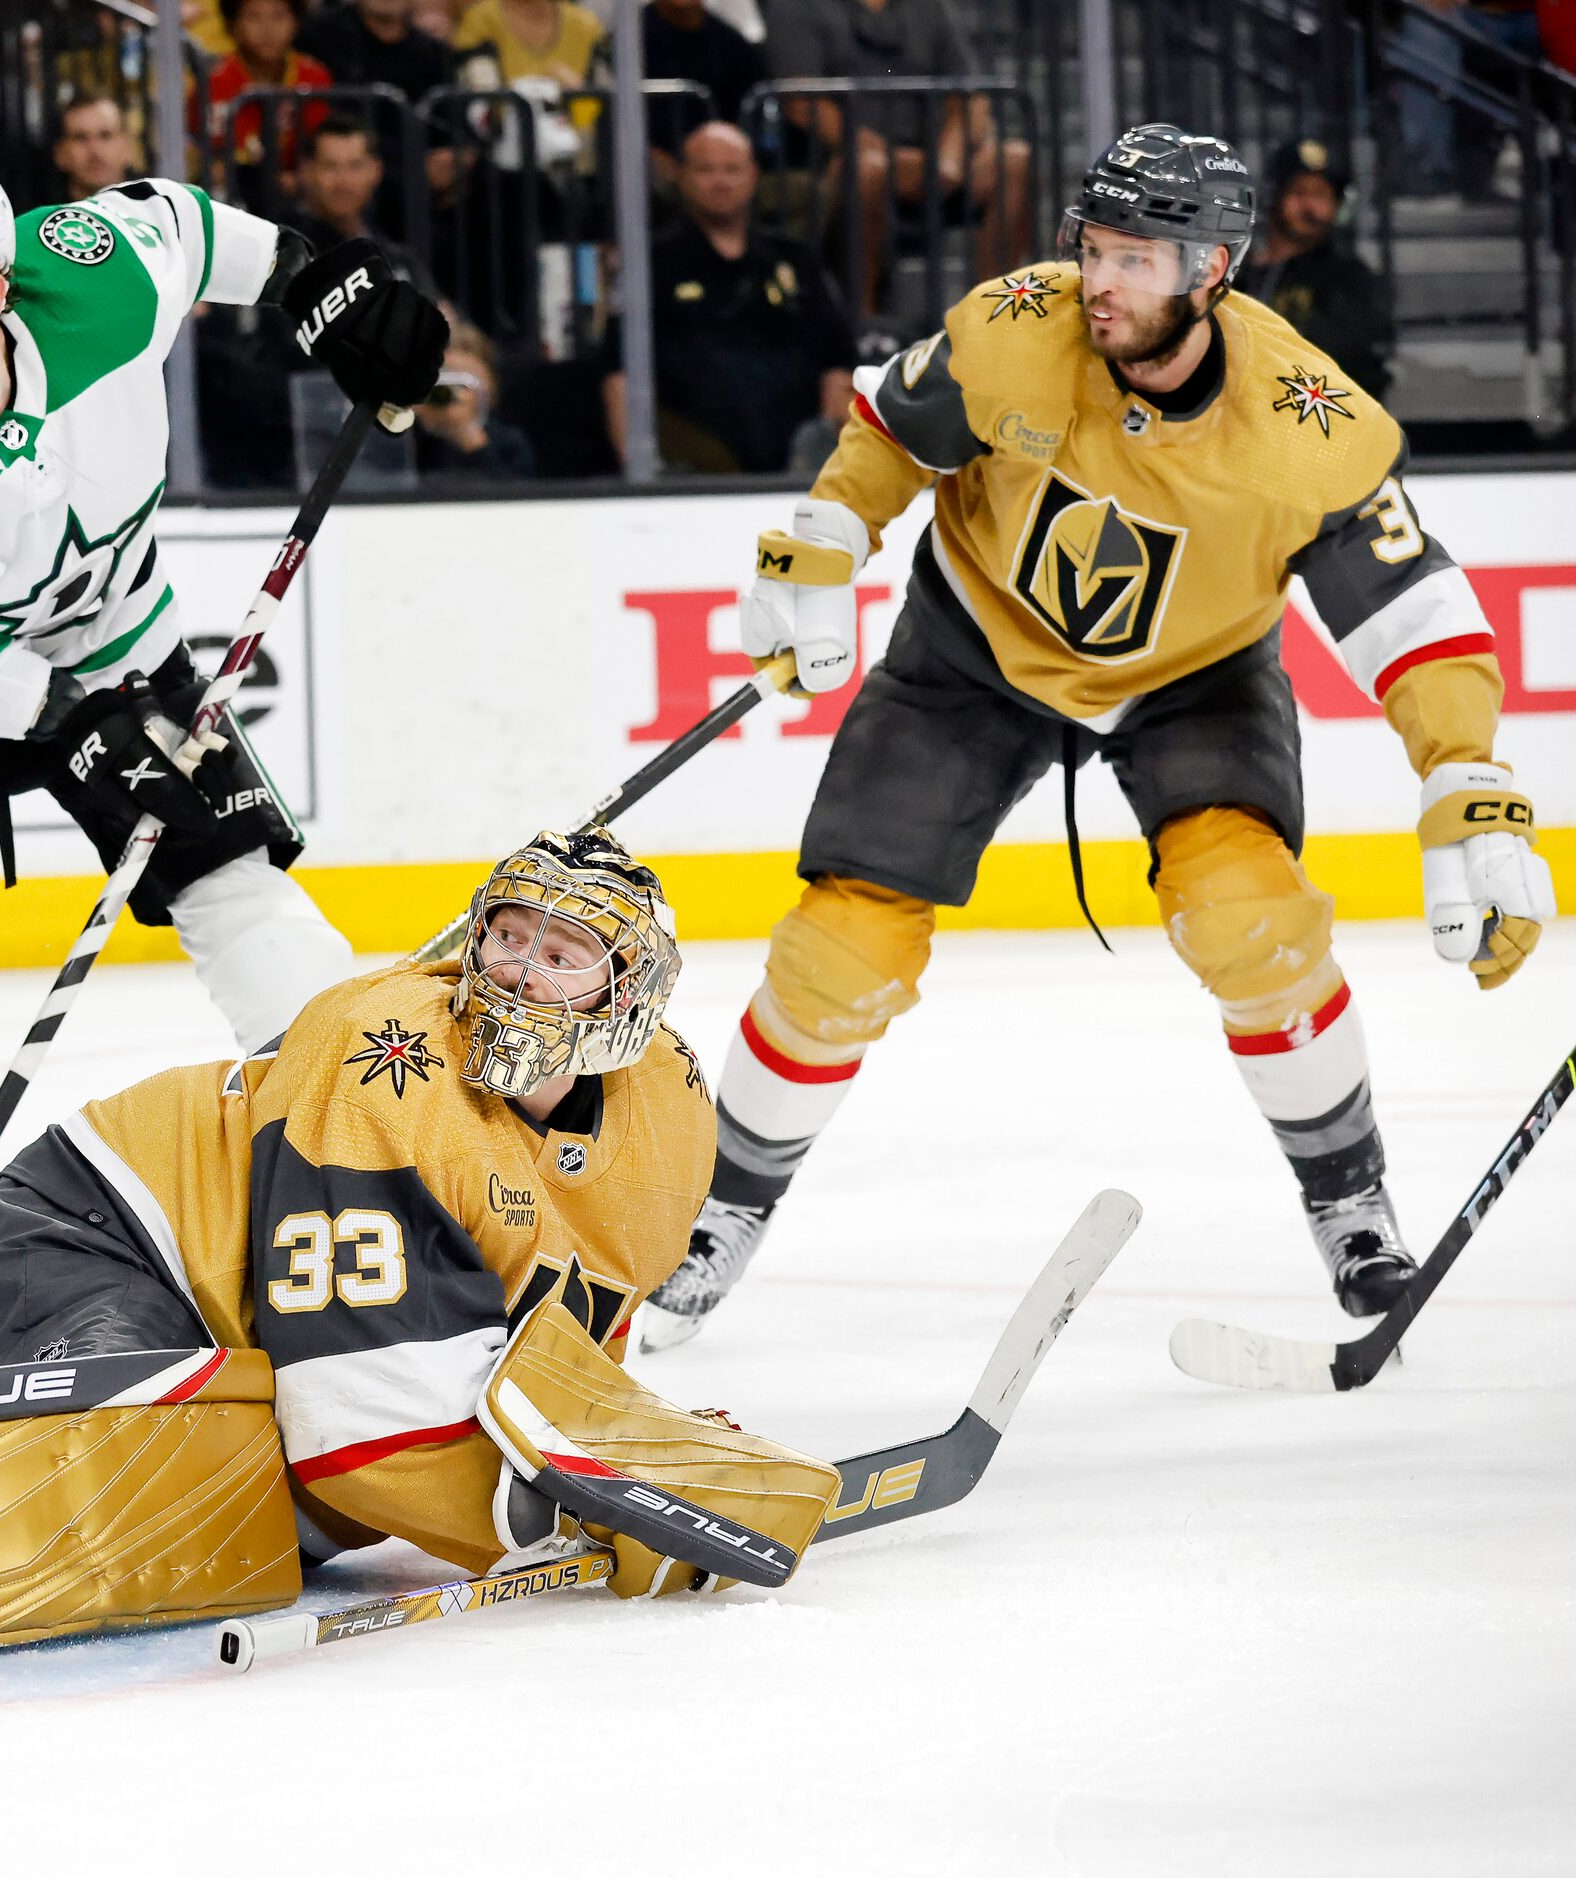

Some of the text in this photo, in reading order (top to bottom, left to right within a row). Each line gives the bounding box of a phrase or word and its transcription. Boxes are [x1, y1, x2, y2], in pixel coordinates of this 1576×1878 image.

[1092, 181, 1140, 203] CCM
[1357, 476, 1425, 565] 3
[810, 651, 848, 670] CCM
[460, 1013, 545, 1098] 33
[563, 1149, 583, 1168] NHL
[488, 1172, 536, 1213] Circa
[504, 1209, 536, 1227] SPORTS
[267, 1208, 408, 1315] 33
[824, 1457, 927, 1524] UE
[622, 1485, 791, 1571] TRUE
[332, 1611, 407, 1637] TRUE
